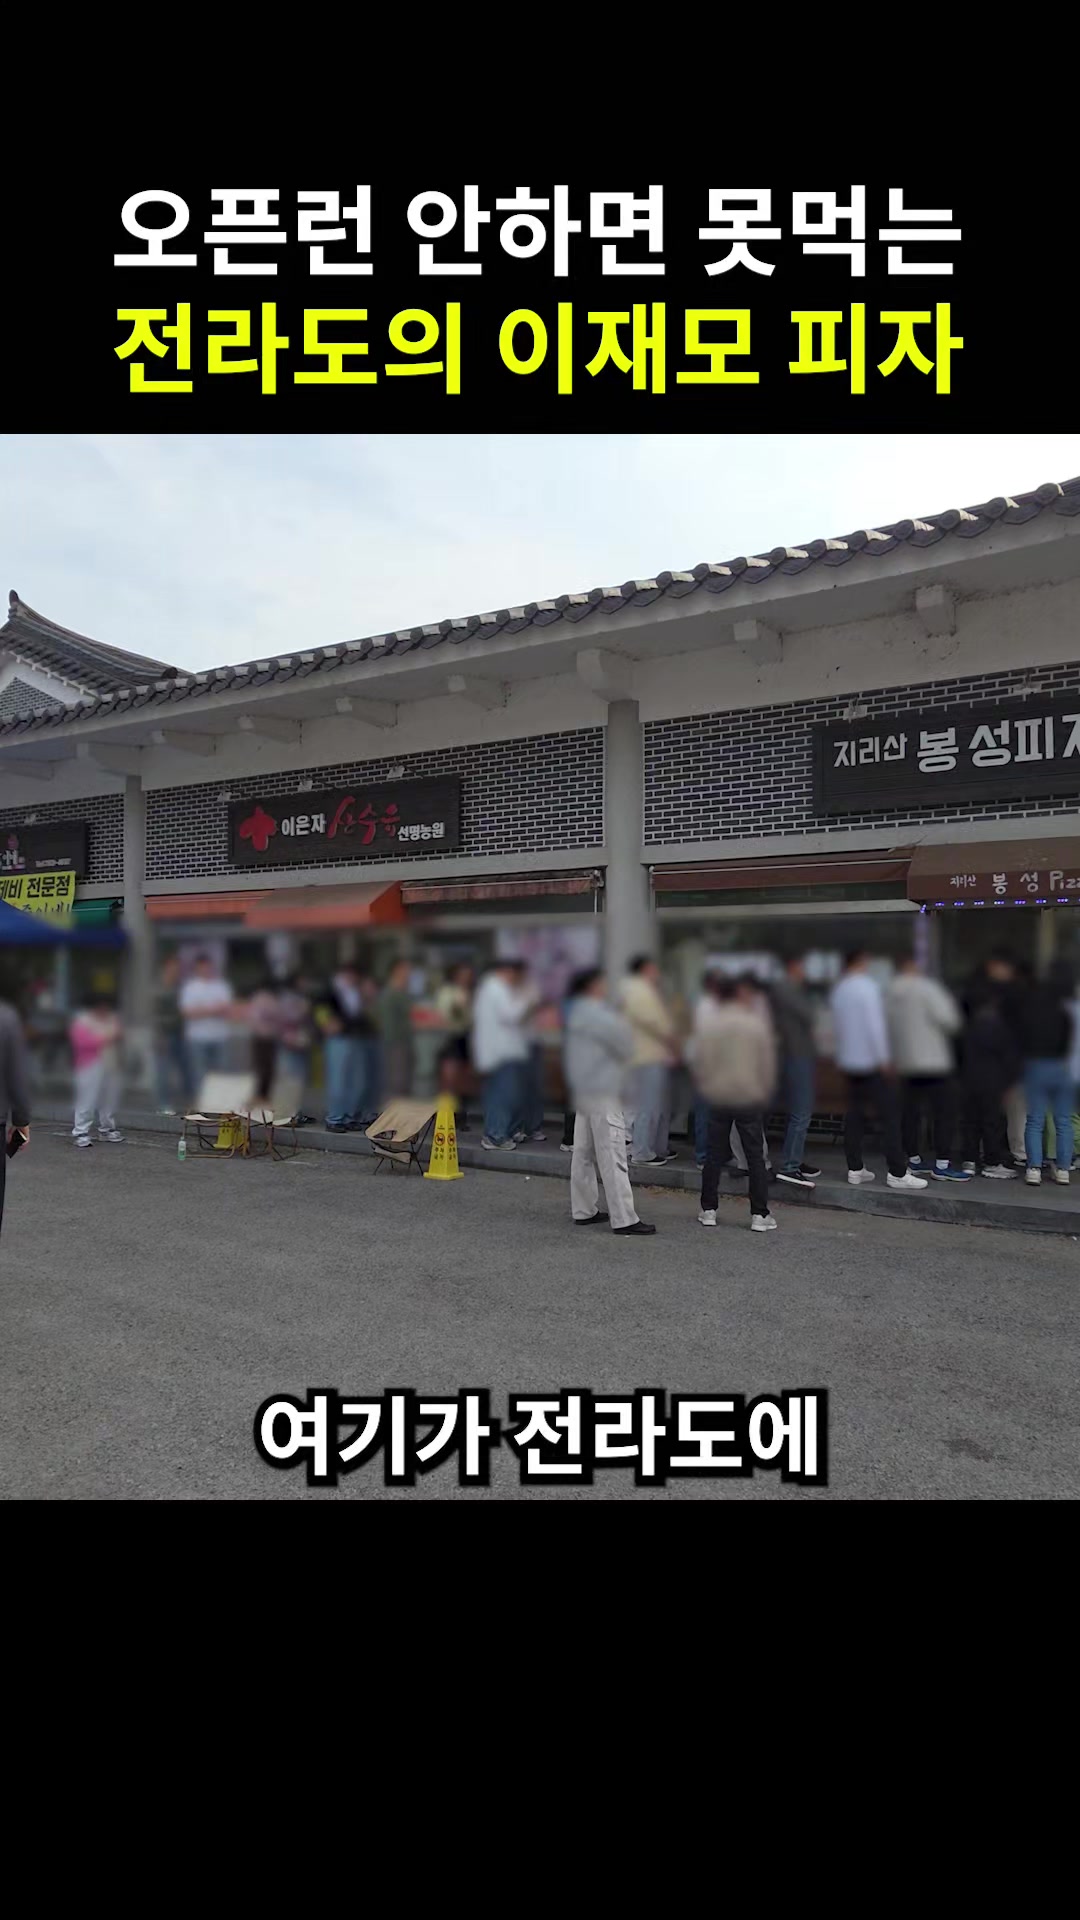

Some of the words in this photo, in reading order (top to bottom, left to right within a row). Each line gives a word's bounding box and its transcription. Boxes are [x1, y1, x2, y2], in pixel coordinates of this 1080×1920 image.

[833, 733, 908, 768] 지리산
[281, 813, 327, 837] 이은자
[327, 795, 401, 845] 산수유
[397, 821, 446, 842] 선명농원
[27, 874, 70, 899] 전문점
[950, 874, 977, 889] 지리산
